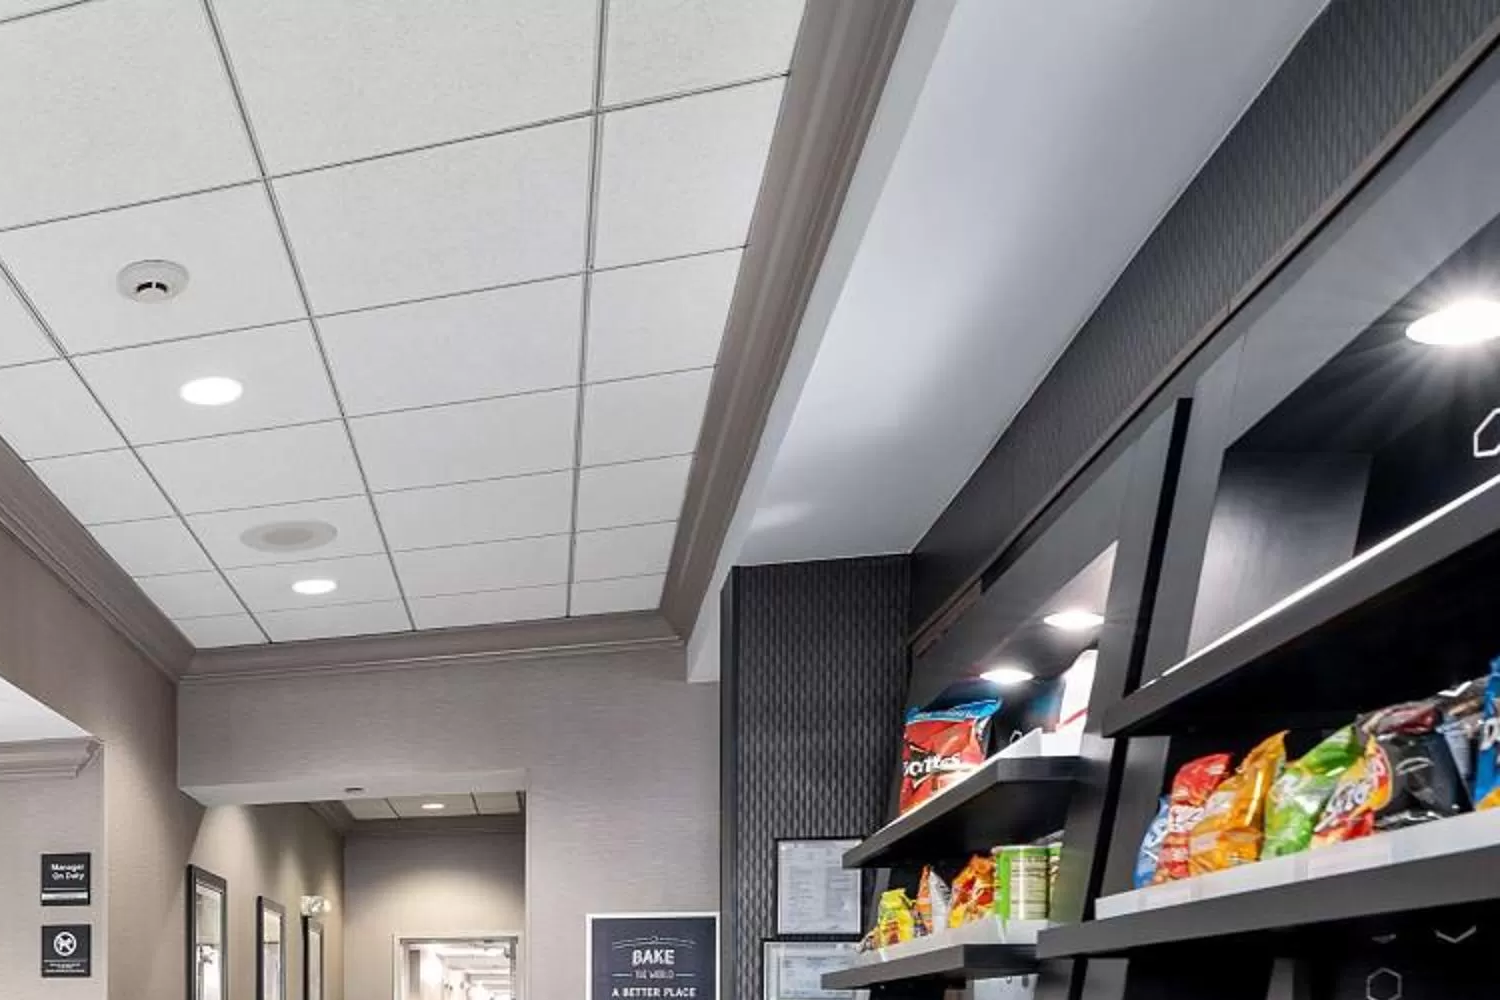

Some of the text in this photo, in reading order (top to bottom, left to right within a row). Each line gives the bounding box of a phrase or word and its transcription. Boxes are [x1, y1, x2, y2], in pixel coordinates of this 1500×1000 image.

[52, 864, 85, 873] Manager
[631, 949, 675, 966] BAKE
[611, 987, 697, 997] A BETTER PLACE
